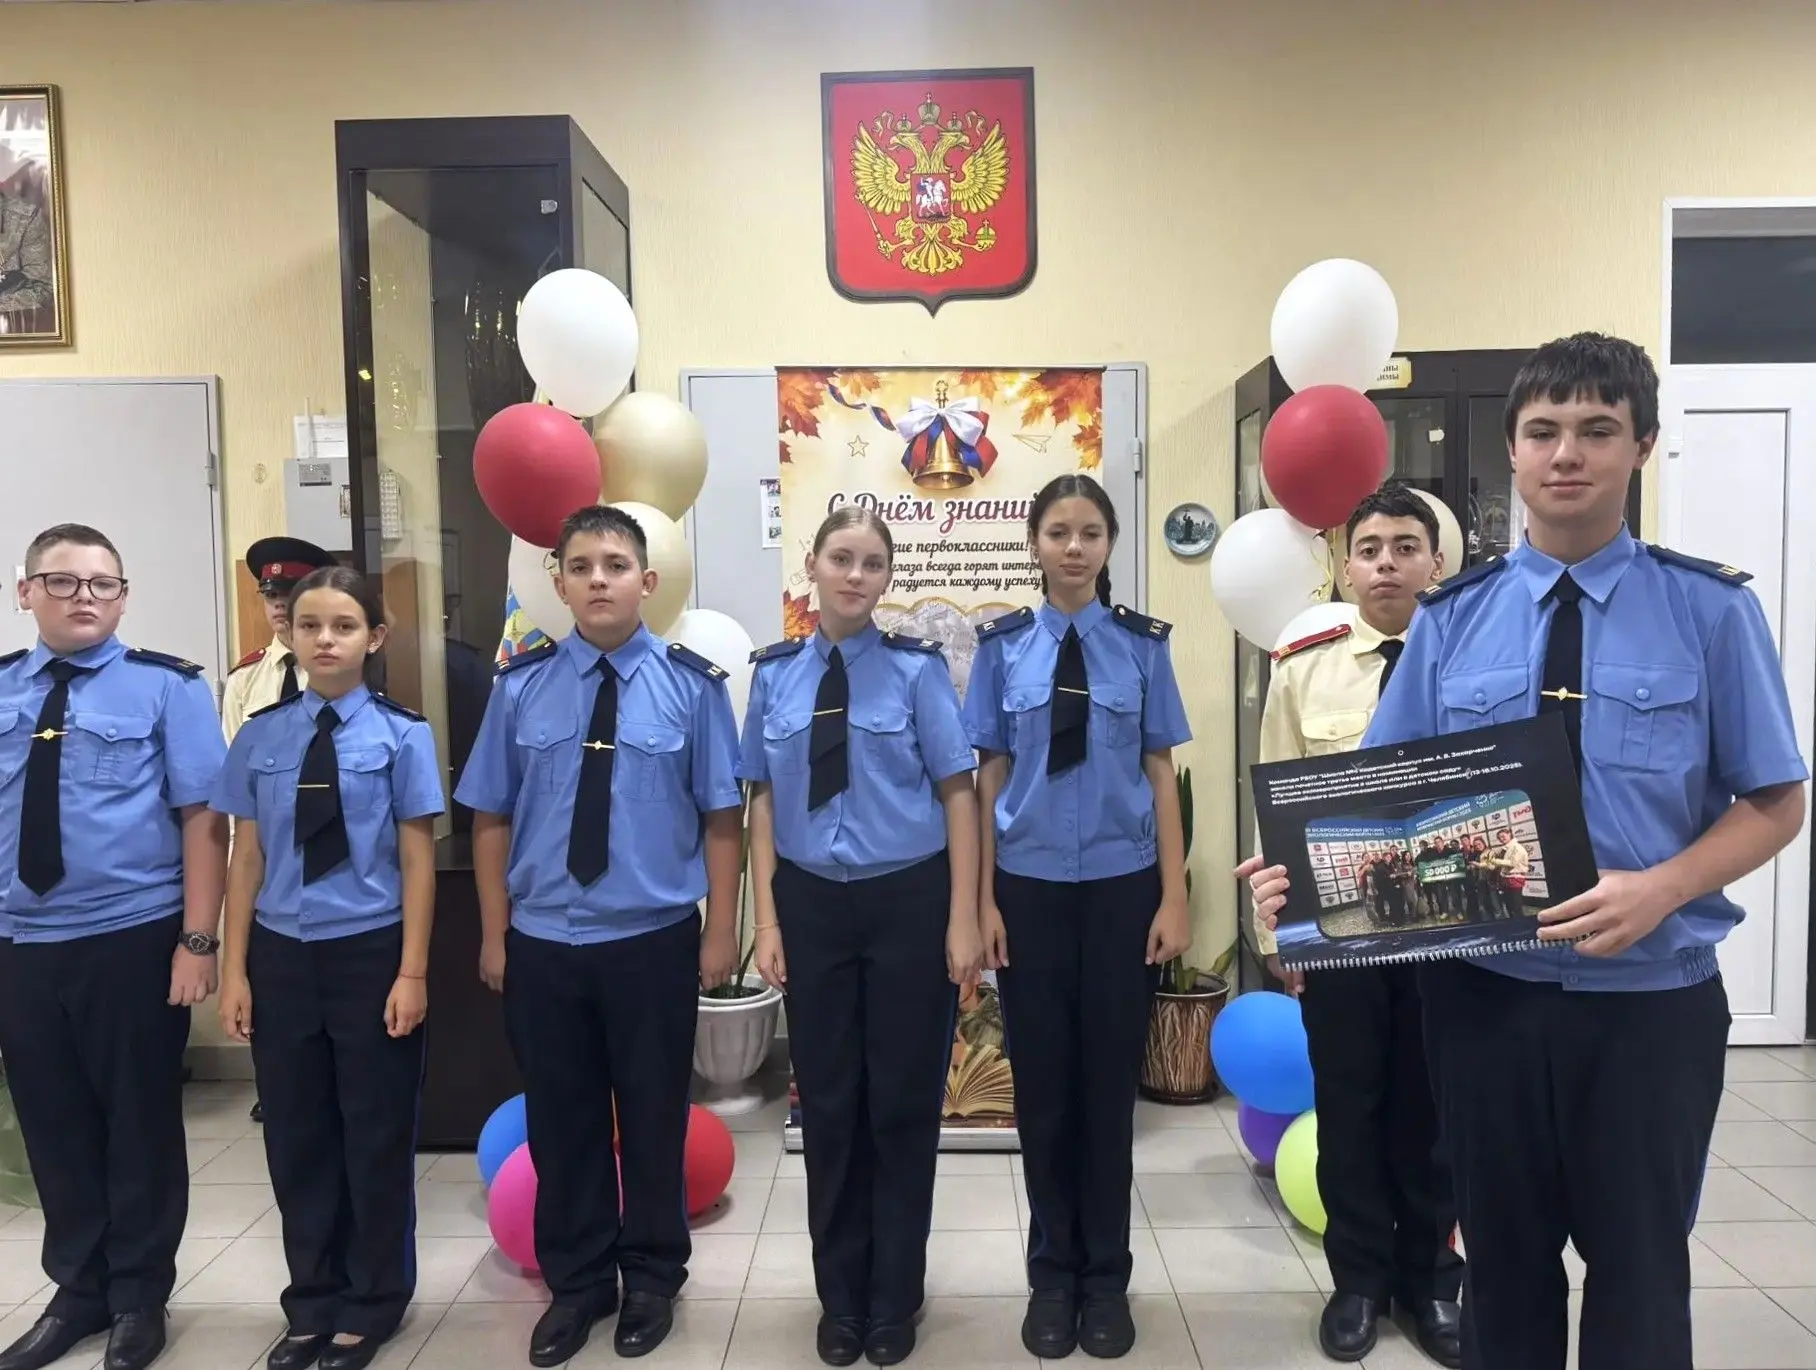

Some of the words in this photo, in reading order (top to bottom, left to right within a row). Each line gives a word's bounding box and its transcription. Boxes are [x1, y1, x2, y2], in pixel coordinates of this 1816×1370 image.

[854, 492, 935, 521] Днём
[916, 539, 1028, 558] первоклассники!
[926, 561, 961, 576] всегда
[964, 562, 999, 576] горят
[892, 579, 946, 592] радуется
[950, 578, 1002, 591] каждому
